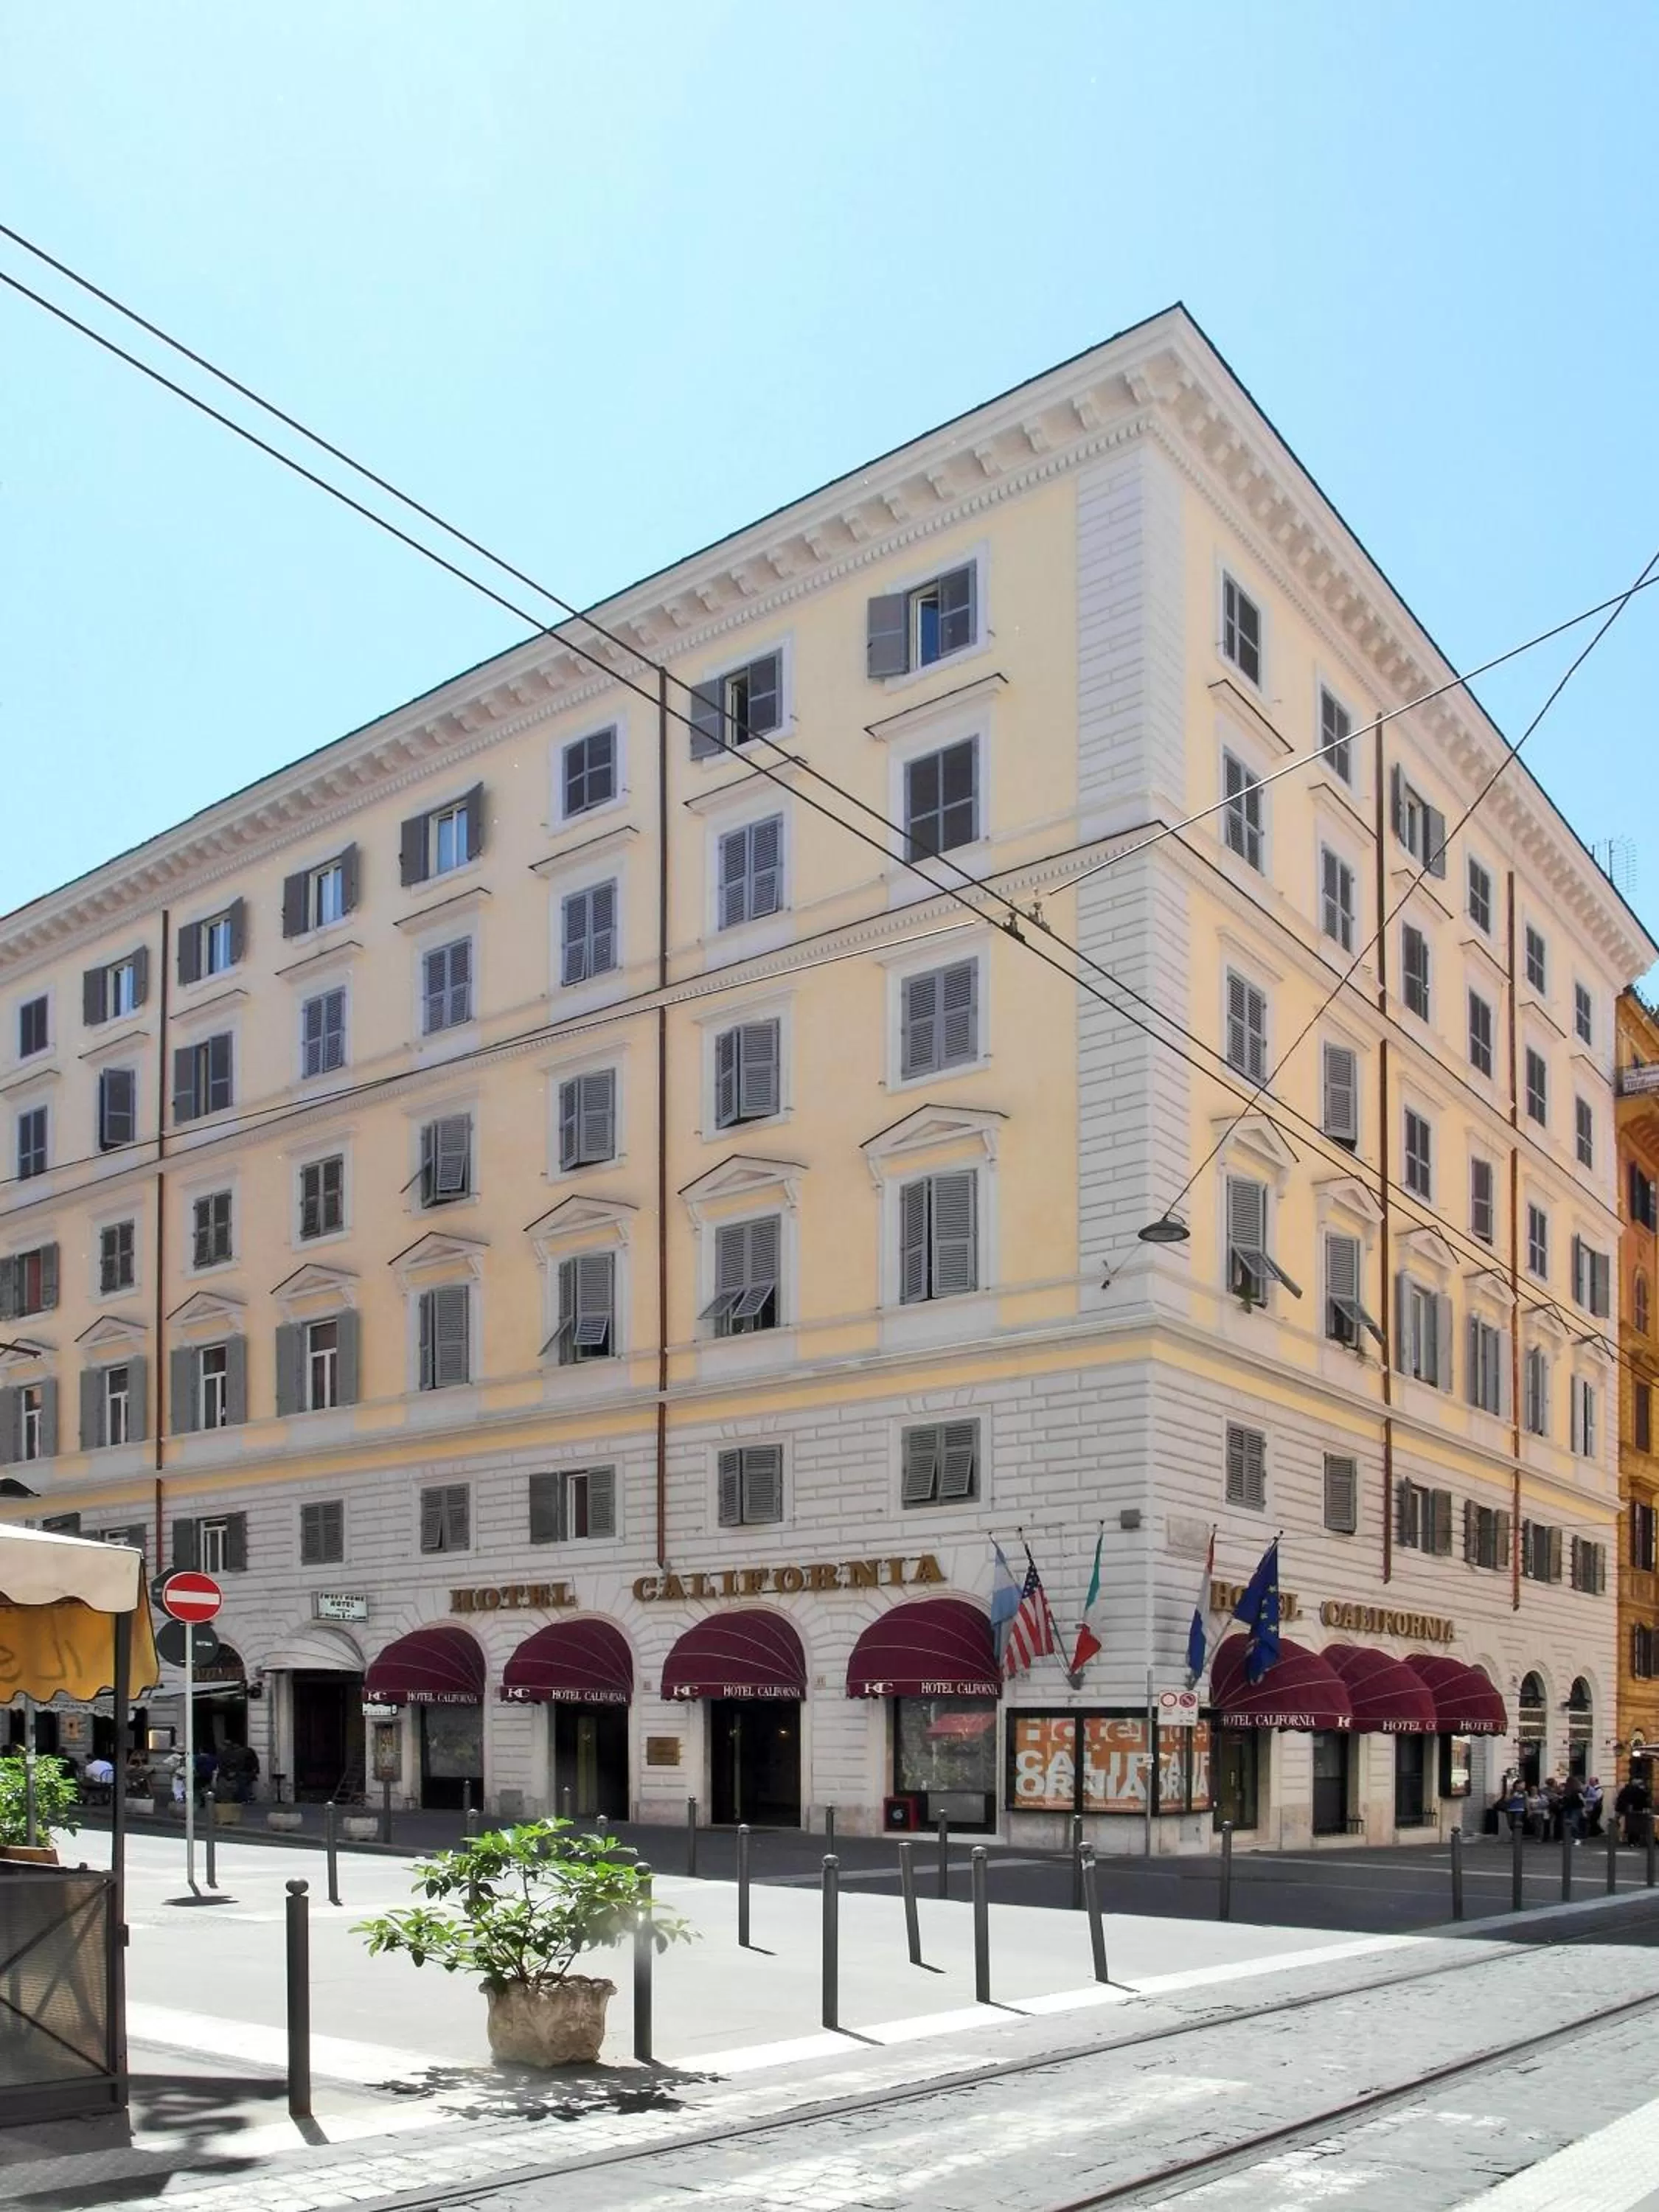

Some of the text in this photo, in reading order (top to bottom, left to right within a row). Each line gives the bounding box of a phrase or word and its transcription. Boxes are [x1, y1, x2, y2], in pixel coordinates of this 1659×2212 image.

[450, 1554, 947, 1613] HOTEL CALIFORNIA
[1210, 1581, 1455, 1643] HOL CALIFORNIA
[723, 1686, 801, 1697] HOTEL CALIFORNIA
[921, 1682, 954, 1694] HOTEL
[407, 1689, 436, 1702] HOTEL
[552, 1689, 581, 1700] HOTEL
[1255, 1714, 1316, 1727] CALIFORNIA
[1382, 1720, 1422, 1731] HOTEL
[1459, 1719, 1495, 1731] HOTEL
